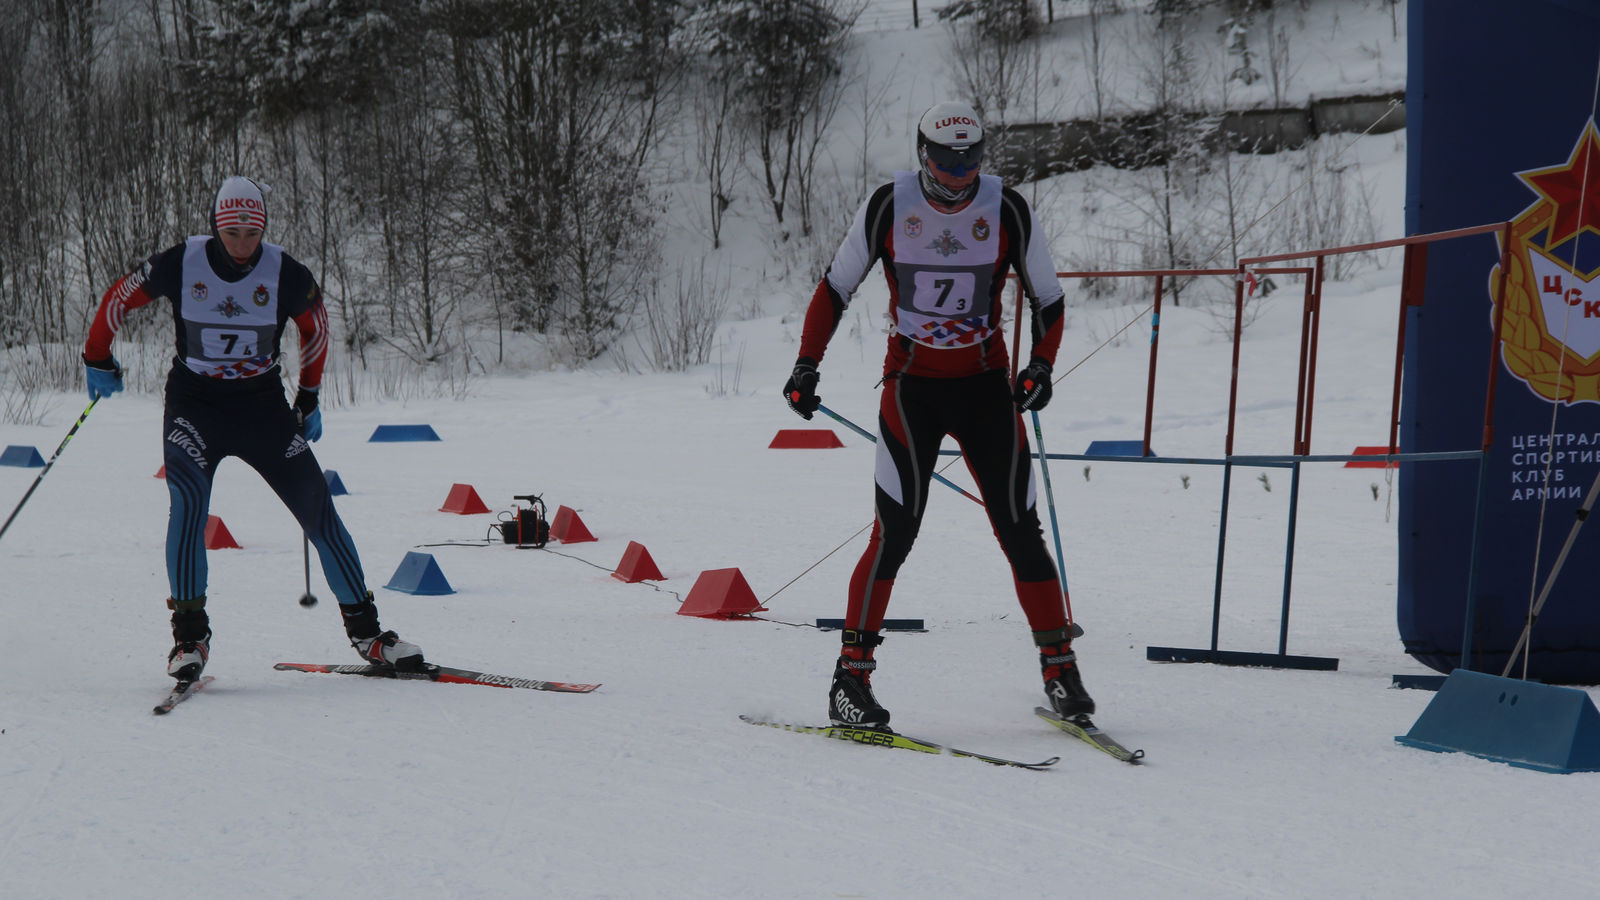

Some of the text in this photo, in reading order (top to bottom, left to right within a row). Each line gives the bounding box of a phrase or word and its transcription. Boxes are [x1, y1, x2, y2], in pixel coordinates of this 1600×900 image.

[935, 116, 980, 130] LUKOIL
[219, 198, 264, 212] LUKOIL
[117, 269, 146, 301] LUKOIL
[934, 278, 966, 311] 7 3
[220, 333, 252, 356] 7 4
[167, 428, 209, 469] LUKOIL
[1512, 469, 1565, 484] КЛУБ
[1512, 486, 1582, 501] АРМИИ
[835, 688, 865, 723] ROSSI
[828, 728, 895, 749] FISCHER
